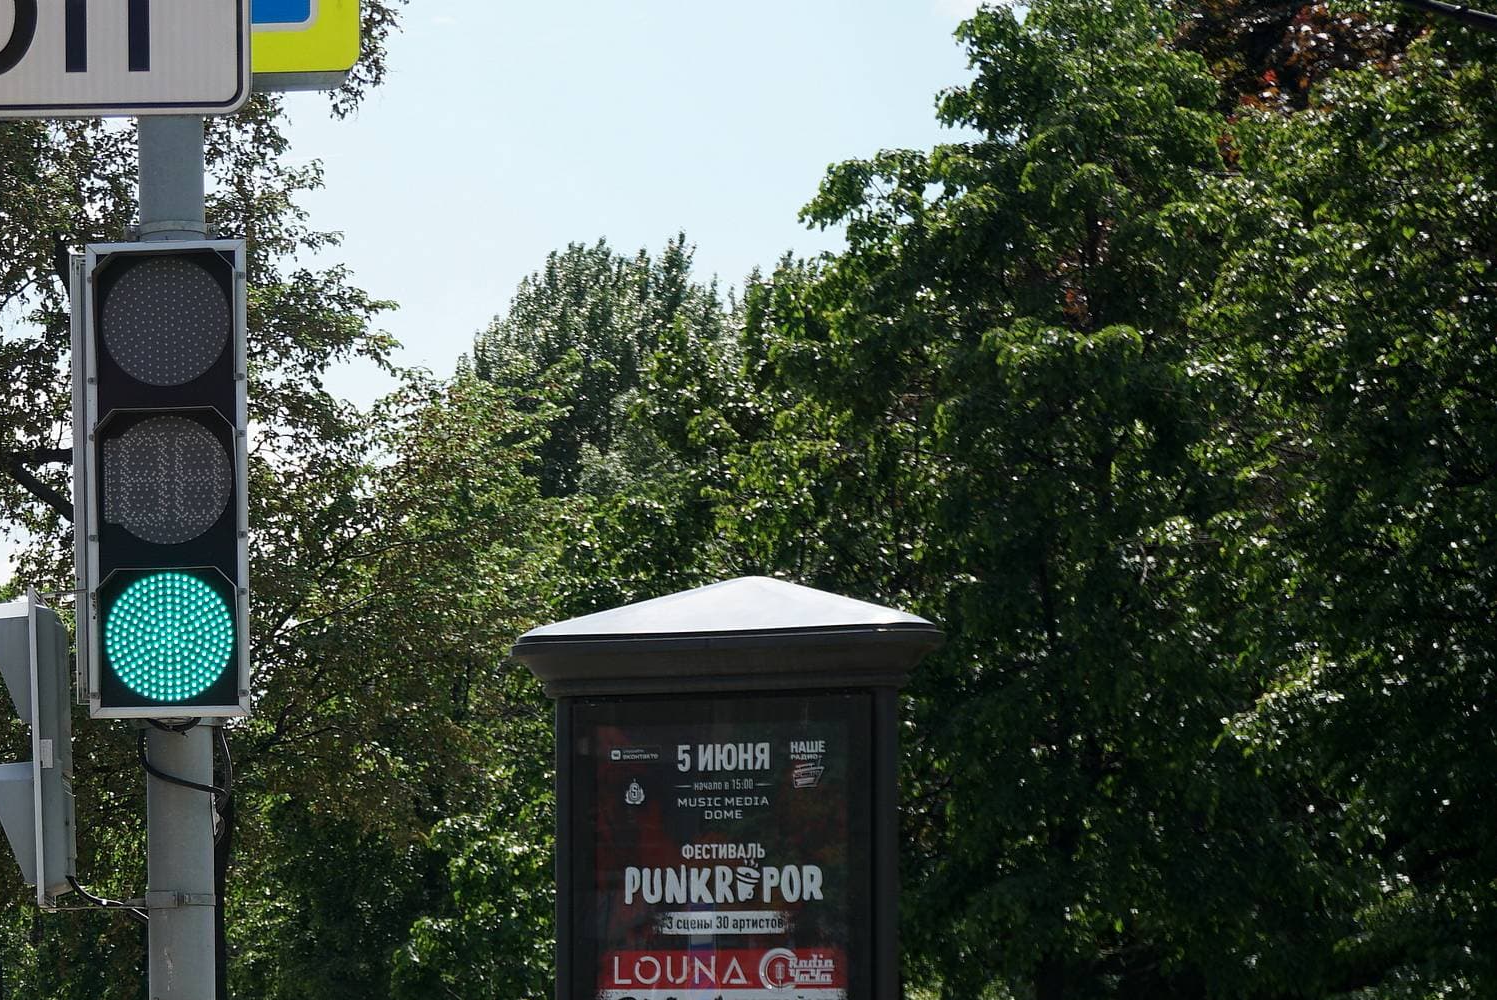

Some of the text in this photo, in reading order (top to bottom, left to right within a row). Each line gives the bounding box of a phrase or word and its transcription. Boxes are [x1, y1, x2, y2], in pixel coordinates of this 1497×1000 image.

[790, 741, 826, 754] НАШЕ
[677, 742, 770, 772] 5 ИЮНЯ
[694, 781, 723, 792] начало
[732, 778, 754, 791] 15:00
[677, 796, 770, 808] MUSIC MEDIA
[704, 809, 744, 820] DOME
[682, 843, 766, 860] ФЕСТИВАЛЬ
[676, 919, 713, 932] сцены
[716, 916, 729, 930] 30
[732, 918, 785, 932] артистов
[614, 955, 749, 985] LOUNA
